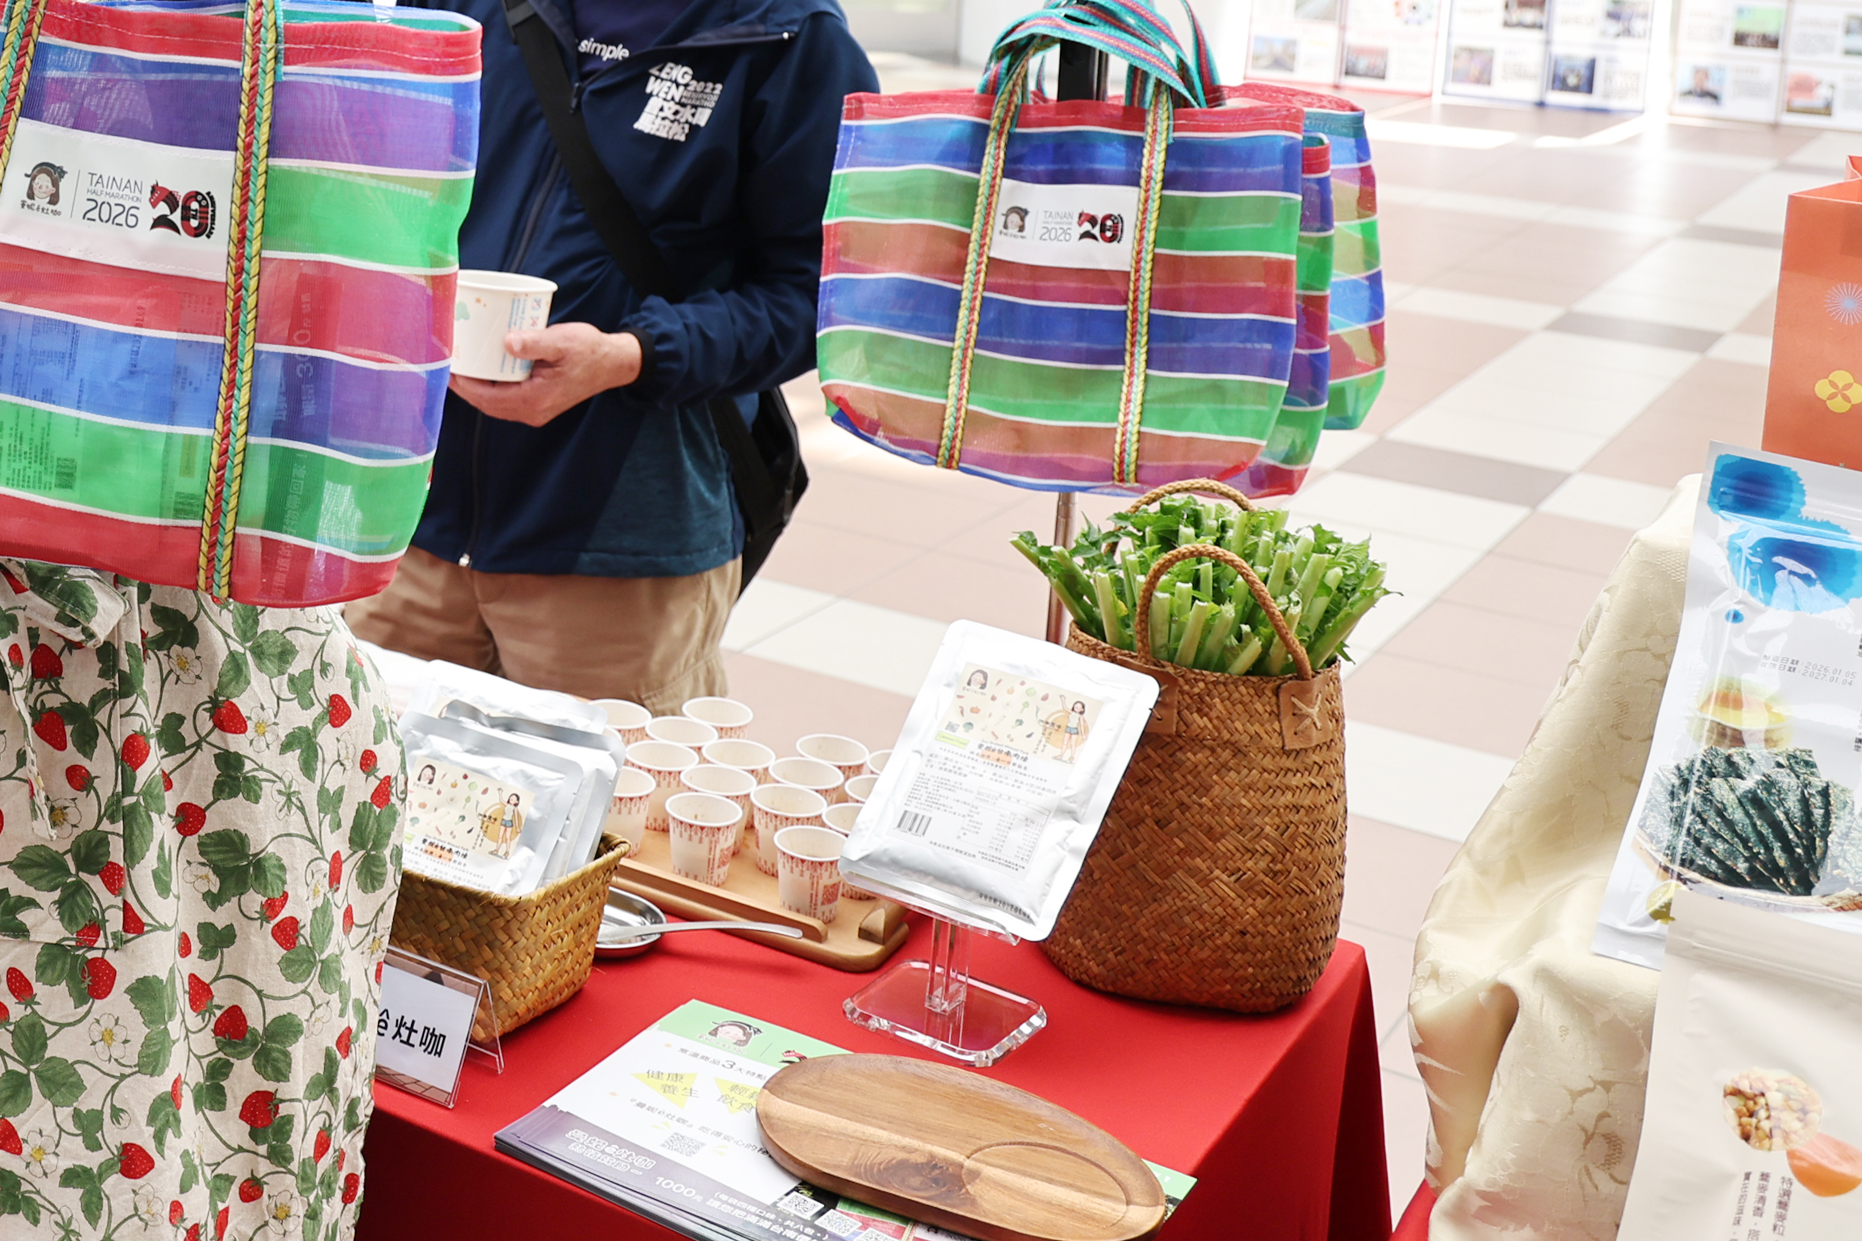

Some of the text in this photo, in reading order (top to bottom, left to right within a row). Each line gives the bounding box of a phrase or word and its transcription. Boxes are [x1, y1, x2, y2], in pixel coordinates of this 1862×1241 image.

[578, 37, 630, 62] simple
[645, 76, 724, 103] WEN 2022
[88, 172, 143, 194] TAINAN
[86, 187, 142, 204] HALF MARATHON
[82, 198, 140, 229] 2026
[1040, 227, 1072, 242] 2026
[646, 1069, 685, 1083] 健康
[660, 1083, 699, 1099] 養生
